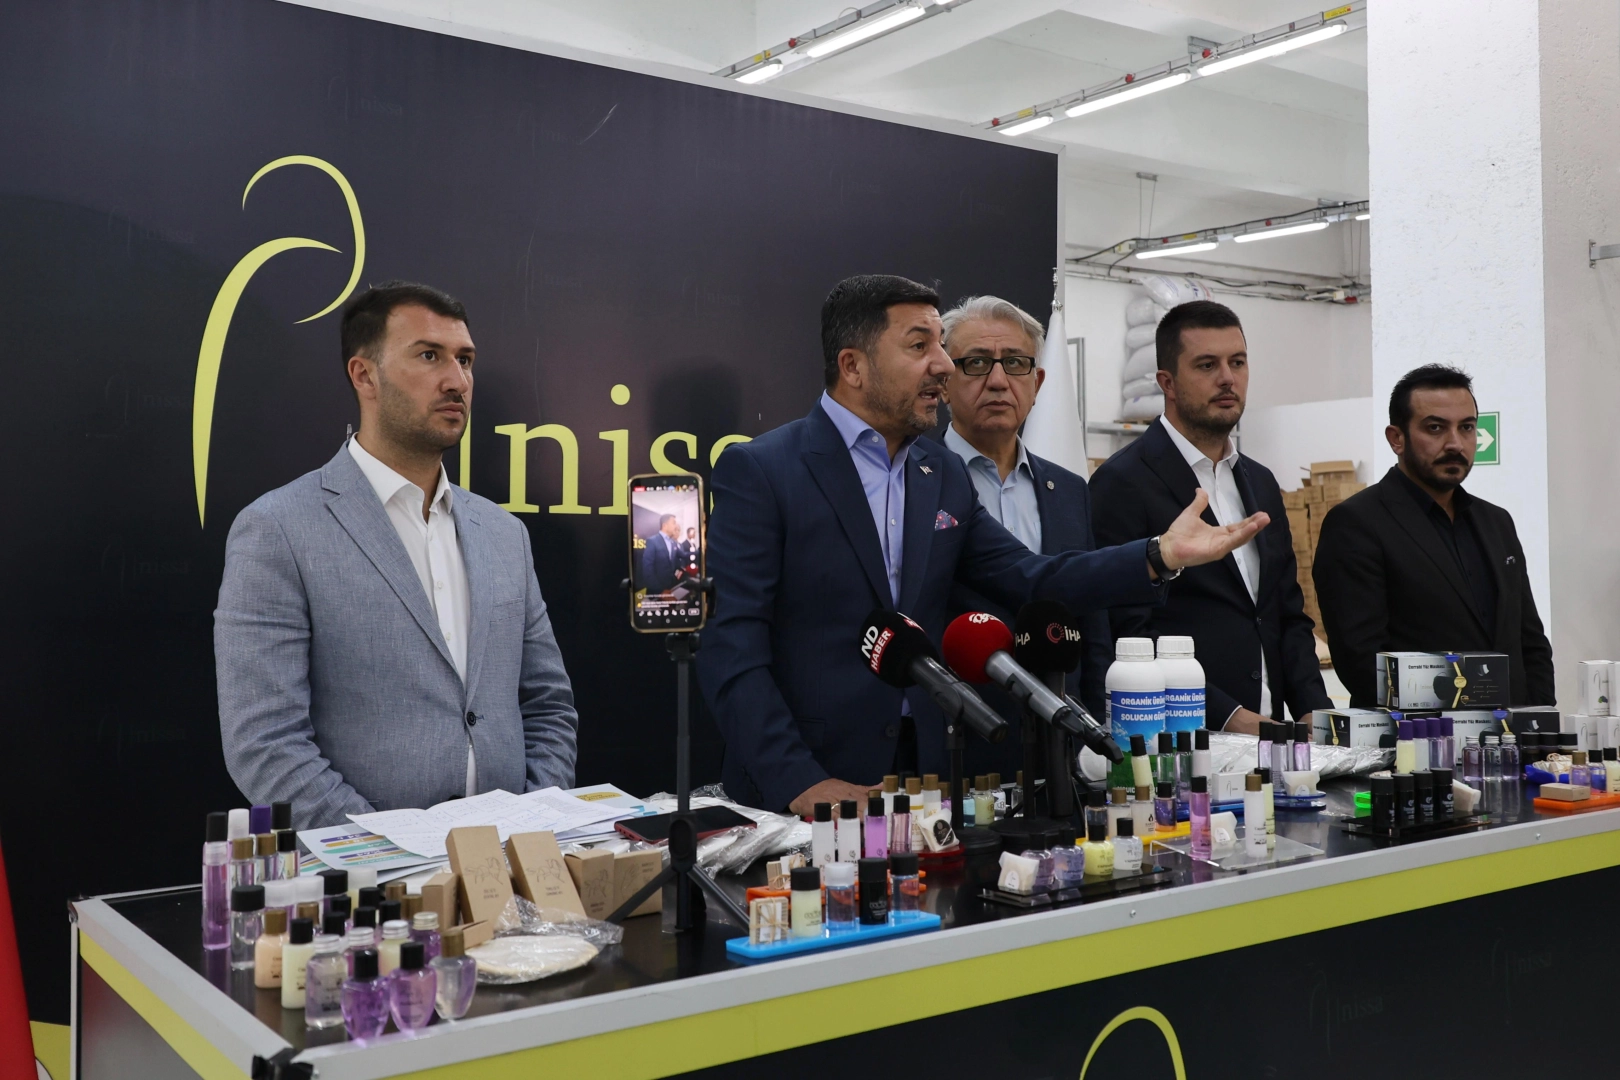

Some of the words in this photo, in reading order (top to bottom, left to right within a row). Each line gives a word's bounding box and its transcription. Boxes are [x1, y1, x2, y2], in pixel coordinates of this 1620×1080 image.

[1064, 625, 1081, 642] İHA
[861, 625, 879, 660] ND
[870, 629, 892, 671] HABER
[1121, 696, 1152, 706] ORGANİK
[1165, 693, 1191, 702] RGANİK
[1121, 713, 1153, 721] SOLUCAN
[1165, 709, 1192, 717] OLUCAN
